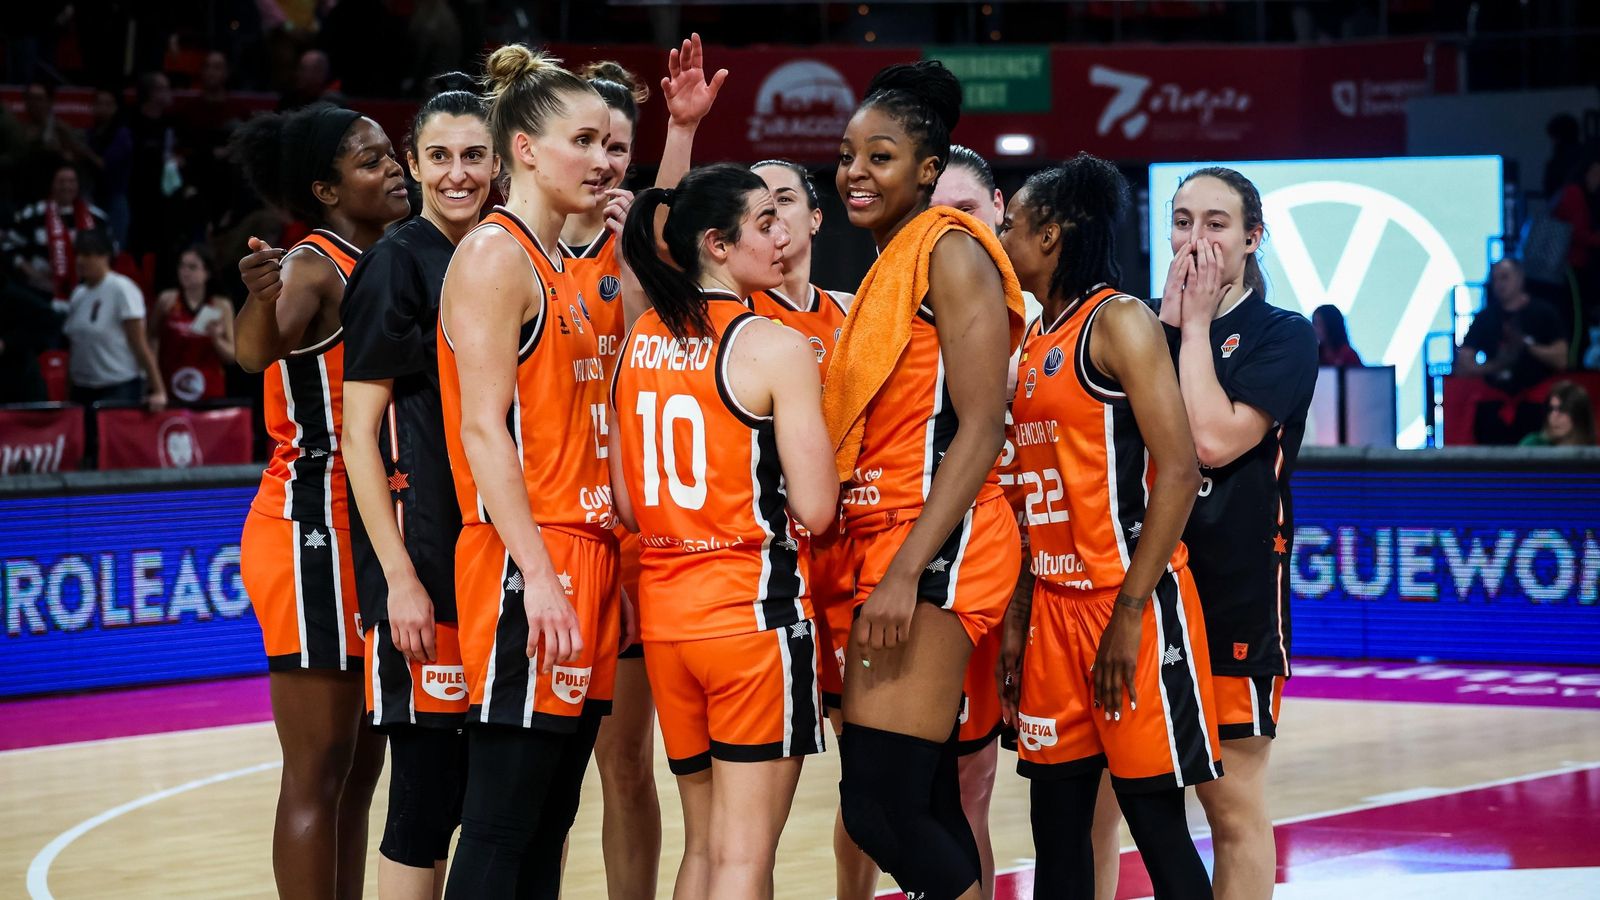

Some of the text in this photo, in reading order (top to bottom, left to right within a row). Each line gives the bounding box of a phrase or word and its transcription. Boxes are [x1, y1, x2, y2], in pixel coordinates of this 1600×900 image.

[630, 334, 713, 370] ROMERO
[636, 391, 707, 510] 10
[1022, 468, 1070, 526] 22
[426, 670, 466, 684] PULE
